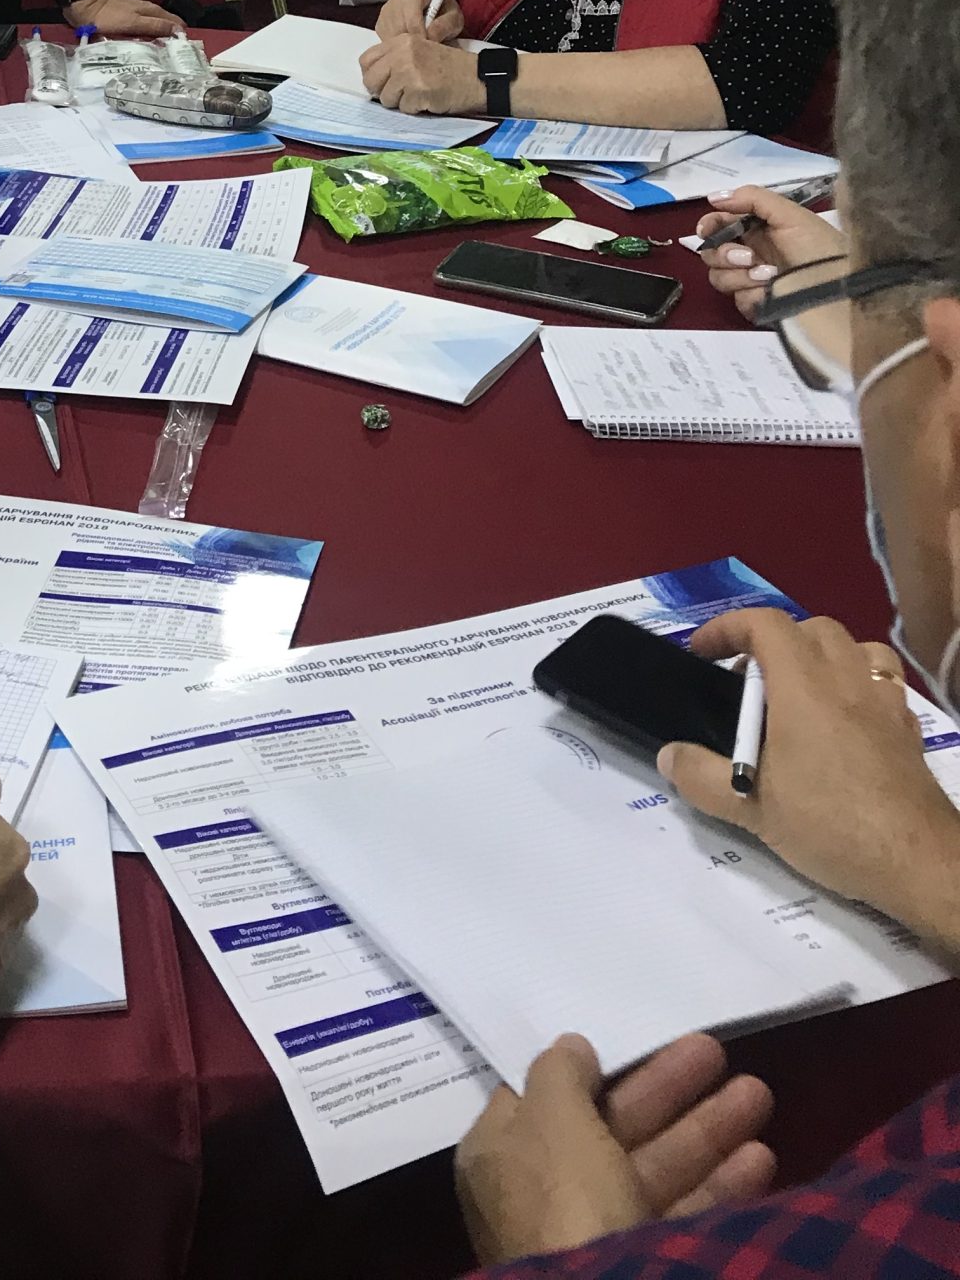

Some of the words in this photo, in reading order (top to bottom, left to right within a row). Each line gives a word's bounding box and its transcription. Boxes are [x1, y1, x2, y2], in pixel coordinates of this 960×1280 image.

[18, 516, 76, 528] ESPGHAN
[77, 522, 109, 531] 2018
[75, 514, 201, 538] НОВОНАРОДЖЕНИХ,
[284, 660, 327, 674] ЩОДО
[329, 638, 449, 667] ПАРЕНТЕРАЛЬНОГО
[451, 619, 530, 646] ХАРЧУВАННЯ
[531, 592, 652, 625] НОВОНАРОДЖЕНИХ,
[286, 665, 366, 685] ВІДПОВІДНО
[368, 661, 388, 673] ДО
[389, 639, 487, 668] РЕКОМЕНДАЦІЙ
[489, 628, 545, 647] ESPGHAN
[546, 619, 578, 633] 2018
[380, 706, 442, 728] Асоціації
[443, 686, 528, 715] неонатологів
[427, 695, 446, 705] За
[448, 679, 515, 703] підтримки
[310, 1076, 354, 1102] Доношені
[355, 1057, 418, 1086] новонароджені
[316, 1094, 354, 1114] першого
[355, 1084, 375, 1101] року
